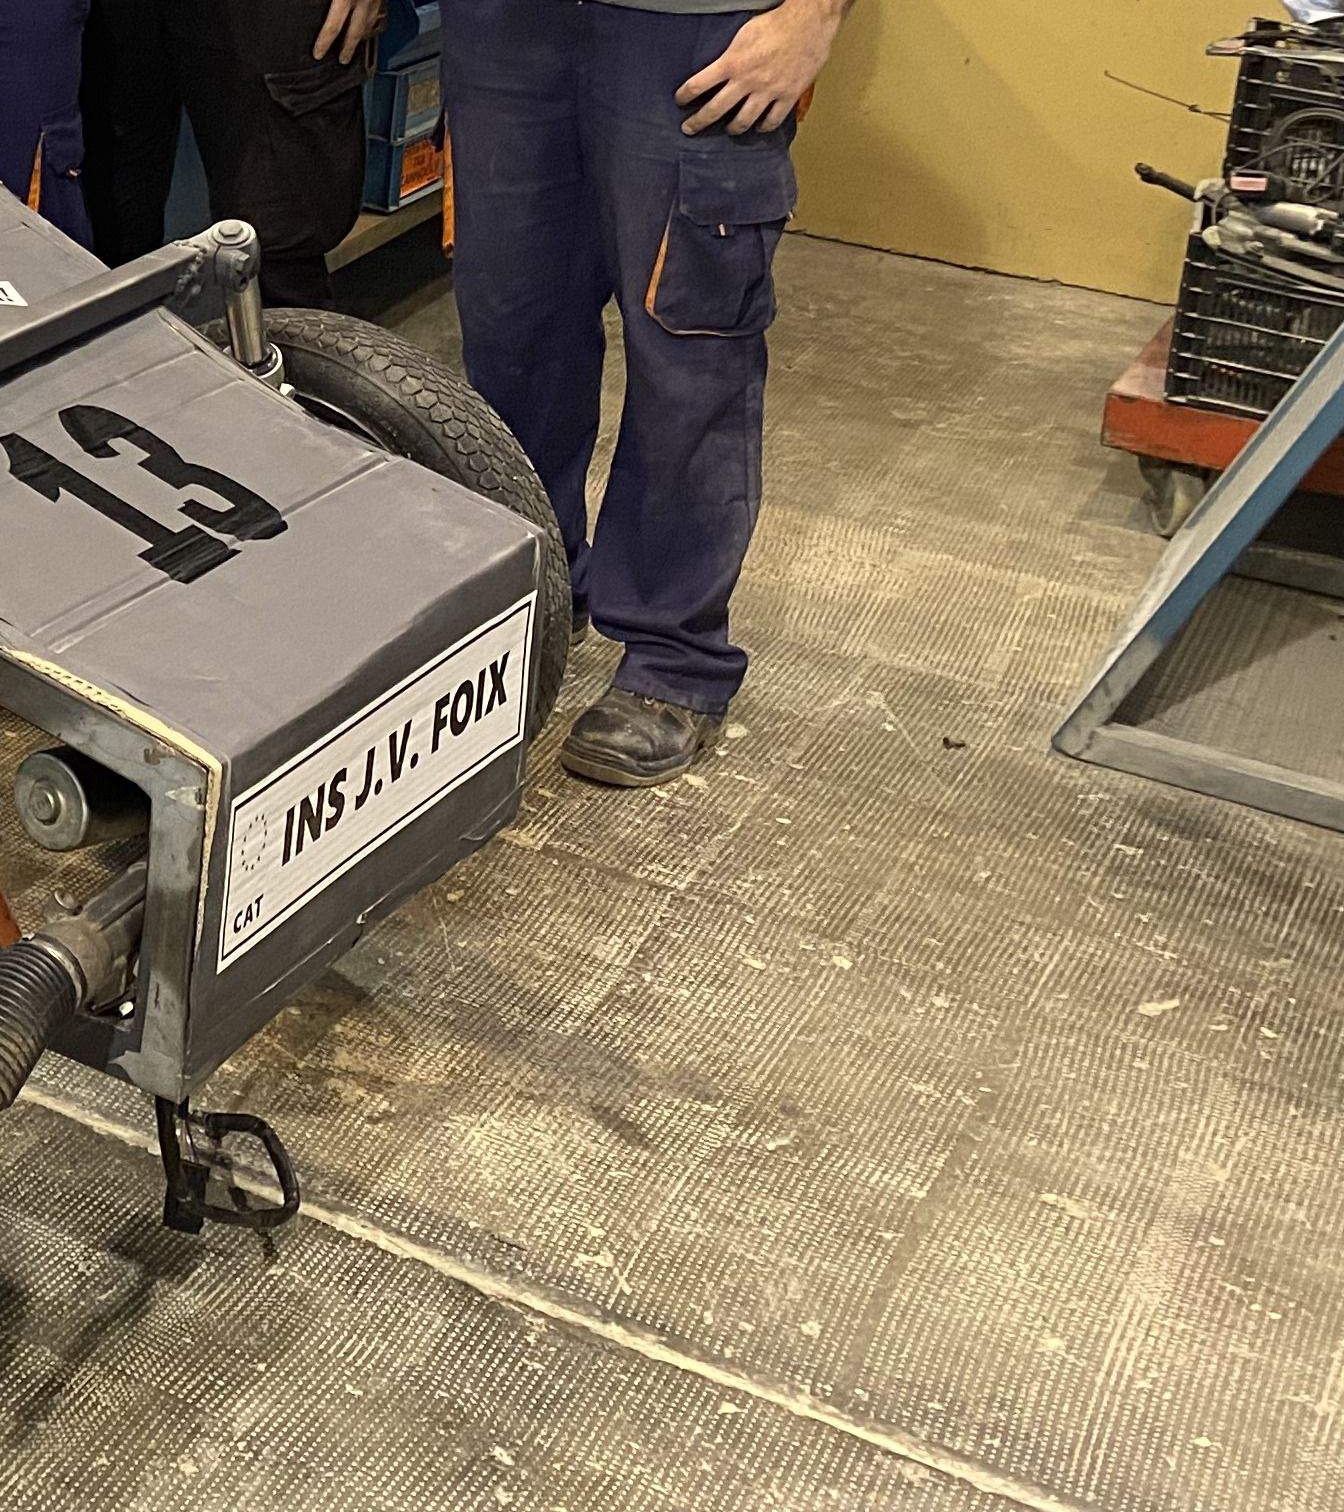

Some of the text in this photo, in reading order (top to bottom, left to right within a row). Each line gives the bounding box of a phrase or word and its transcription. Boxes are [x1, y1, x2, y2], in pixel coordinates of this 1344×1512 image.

[281, 650, 511, 867] INS J.V. FOIX
[232, 894, 264, 935] CAT
